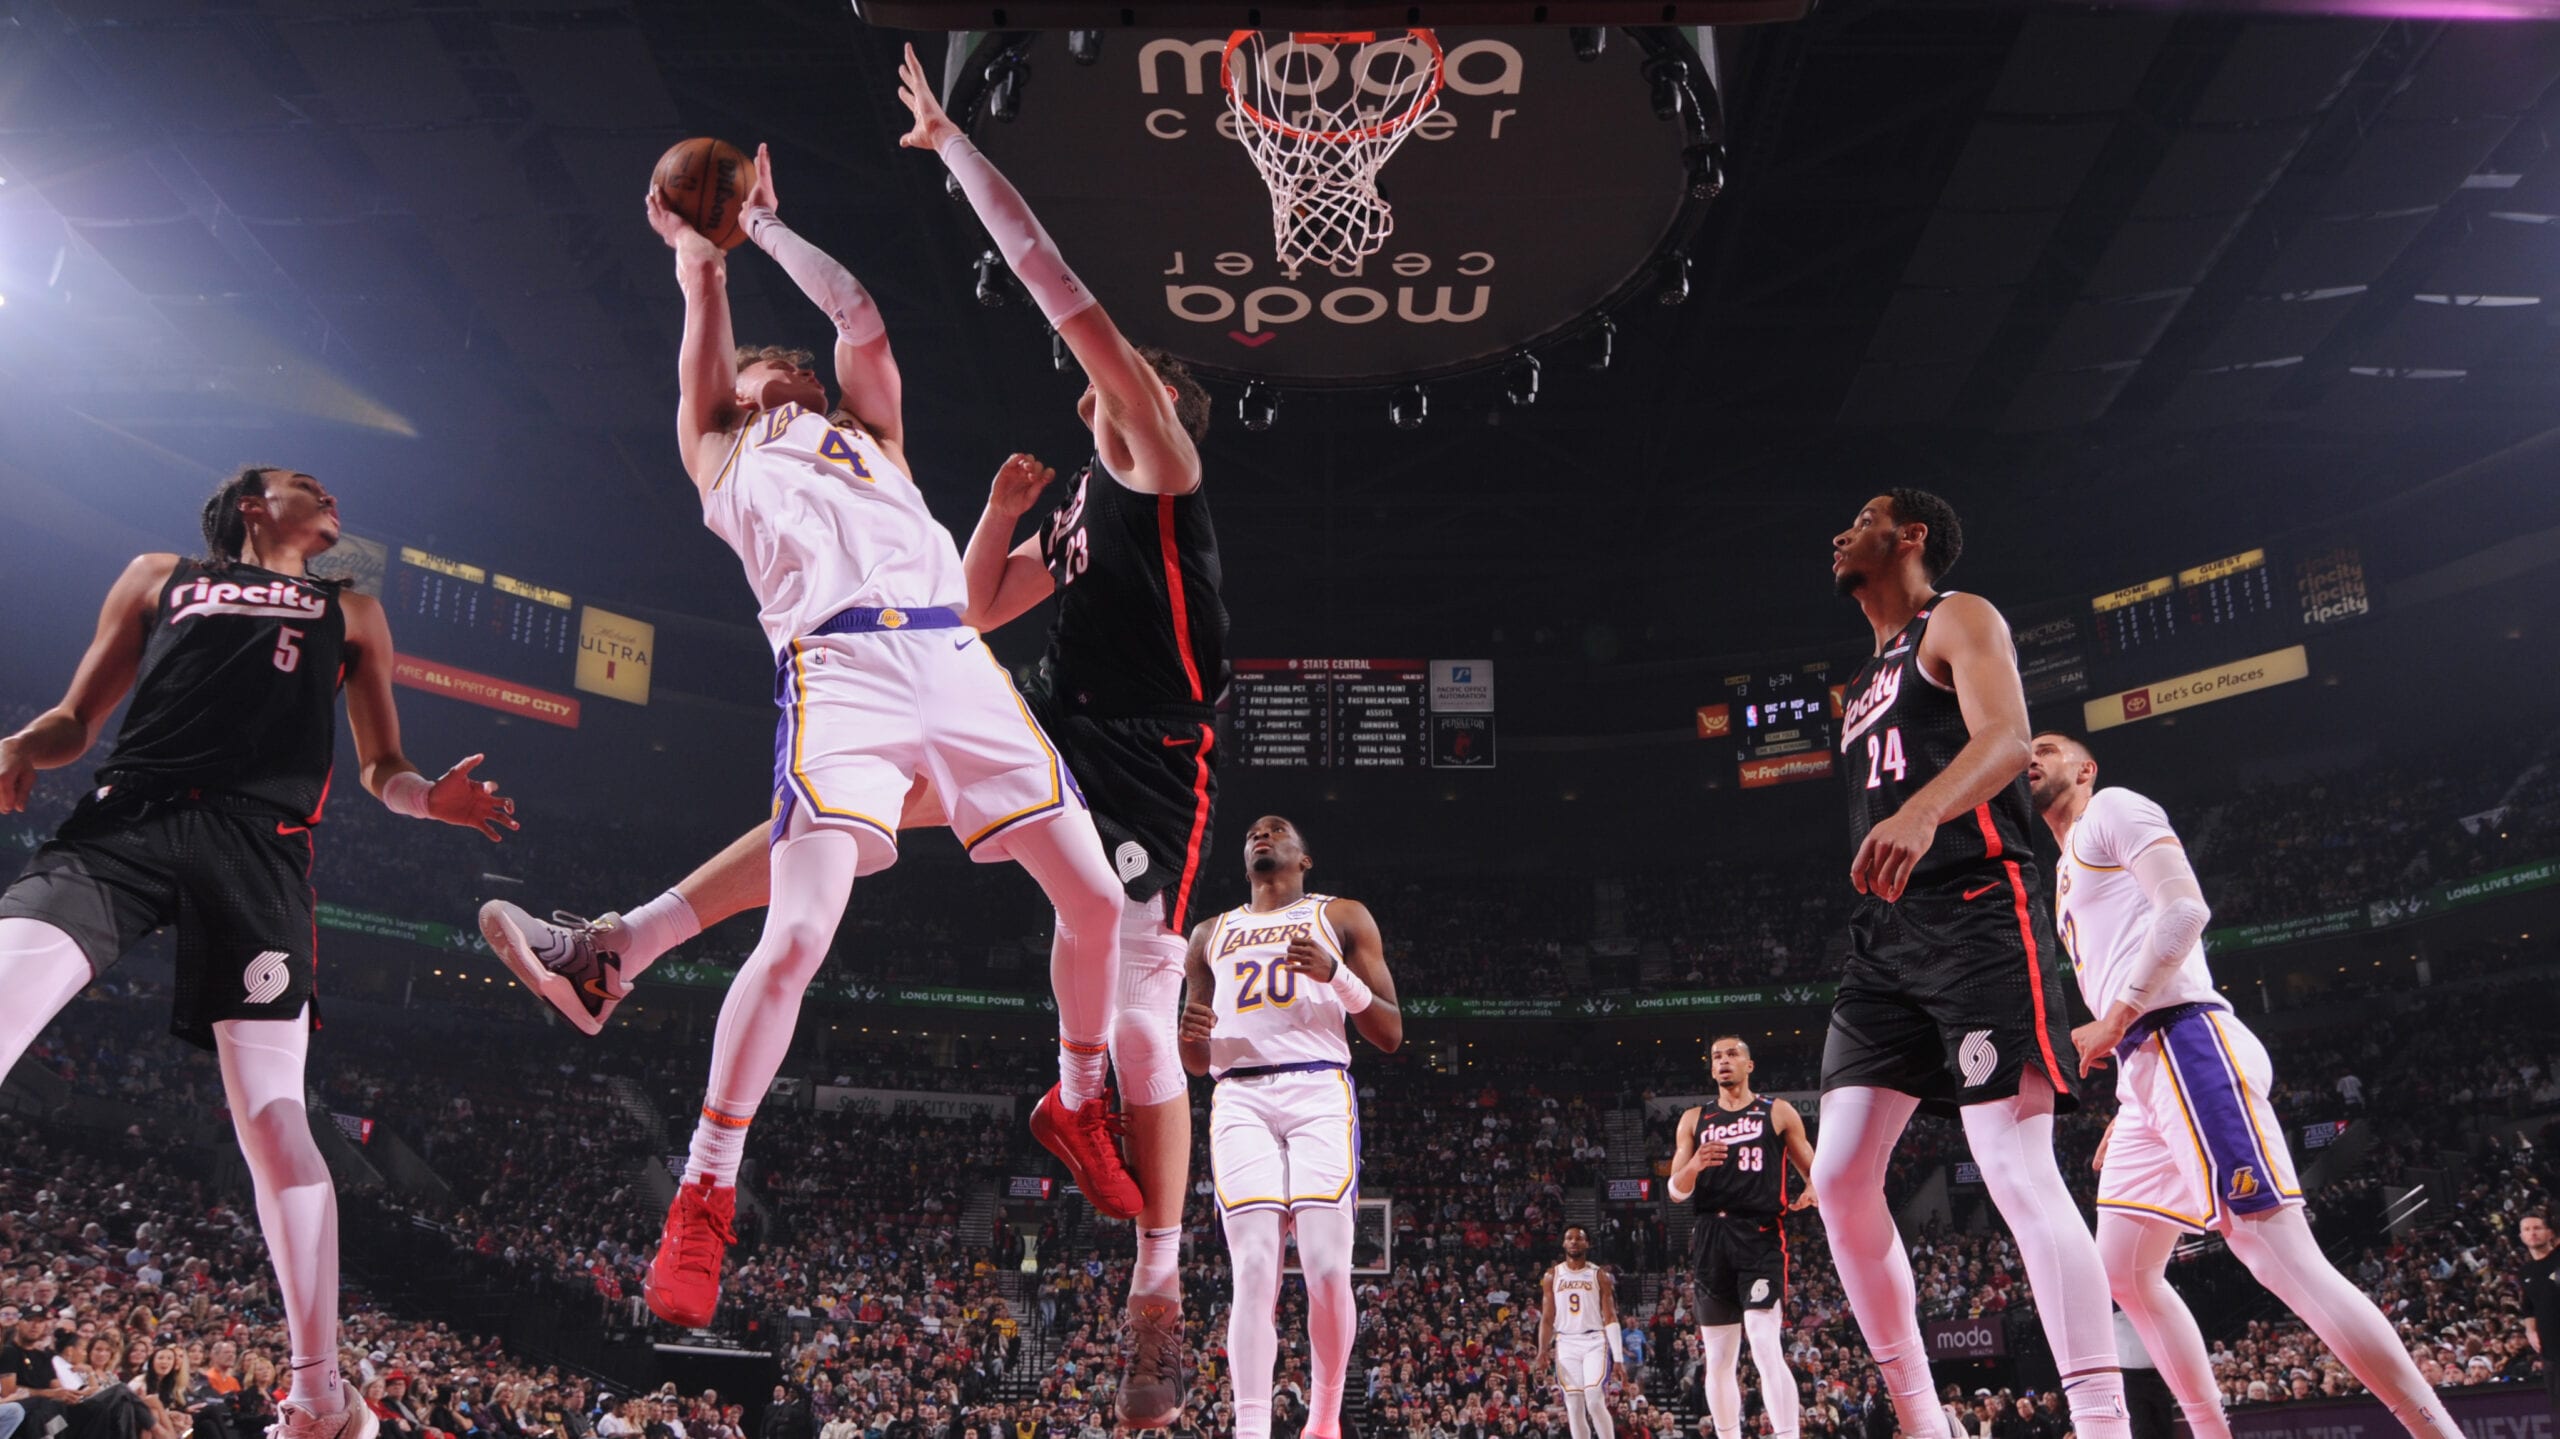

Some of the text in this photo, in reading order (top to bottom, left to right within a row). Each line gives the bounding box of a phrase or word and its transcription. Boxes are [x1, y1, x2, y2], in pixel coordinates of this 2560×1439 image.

[1138, 28, 1524, 94] moda
[1145, 104, 1517, 139] center
[1164, 250, 1495, 281] center
[1165, 285, 1491, 333] moda
[816, 426, 876, 483] 4
[1065, 526, 1089, 585] 23
[2200, 556, 2242, 574] GUEST
[170, 576, 326, 624] ripcity
[2114, 584, 2148, 599] HOME
[2304, 597, 2368, 624] ripcity
[273, 625, 305, 673] 5
[580, 634, 648, 666] ULTRA
[1303, 659, 1370, 669] STATS CENTRAL
[396, 664, 571, 716] ARE ALL PART OF RIP CITY
[2157, 668, 2264, 704] Let's Go Places
[1841, 664, 1903, 753] ipcity
[1866, 727, 1907, 789] 24
[2446, 884, 2481, 901] LONG
[2482, 876, 2511, 892] LIVE
[2512, 866, 2550, 884] SMILE
[321, 916, 416, 940] network of dentists
[336, 907, 353, 918] the
[1216, 922, 1312, 961] LAKERS
[900, 991, 1025, 1007] LONG LIVE SMILE POWER
[1234, 956, 1297, 1014] 20
[1636, 993, 1762, 1008] LONG LIVE SMILE POWER
[1700, 1117, 1763, 1145] ripcity
[1738, 1146, 1763, 1172] 33
[1557, 1279, 1593, 1292] LAKERS
[1569, 1293, 1581, 1314] 9
[1937, 1325, 1992, 1349] moda
